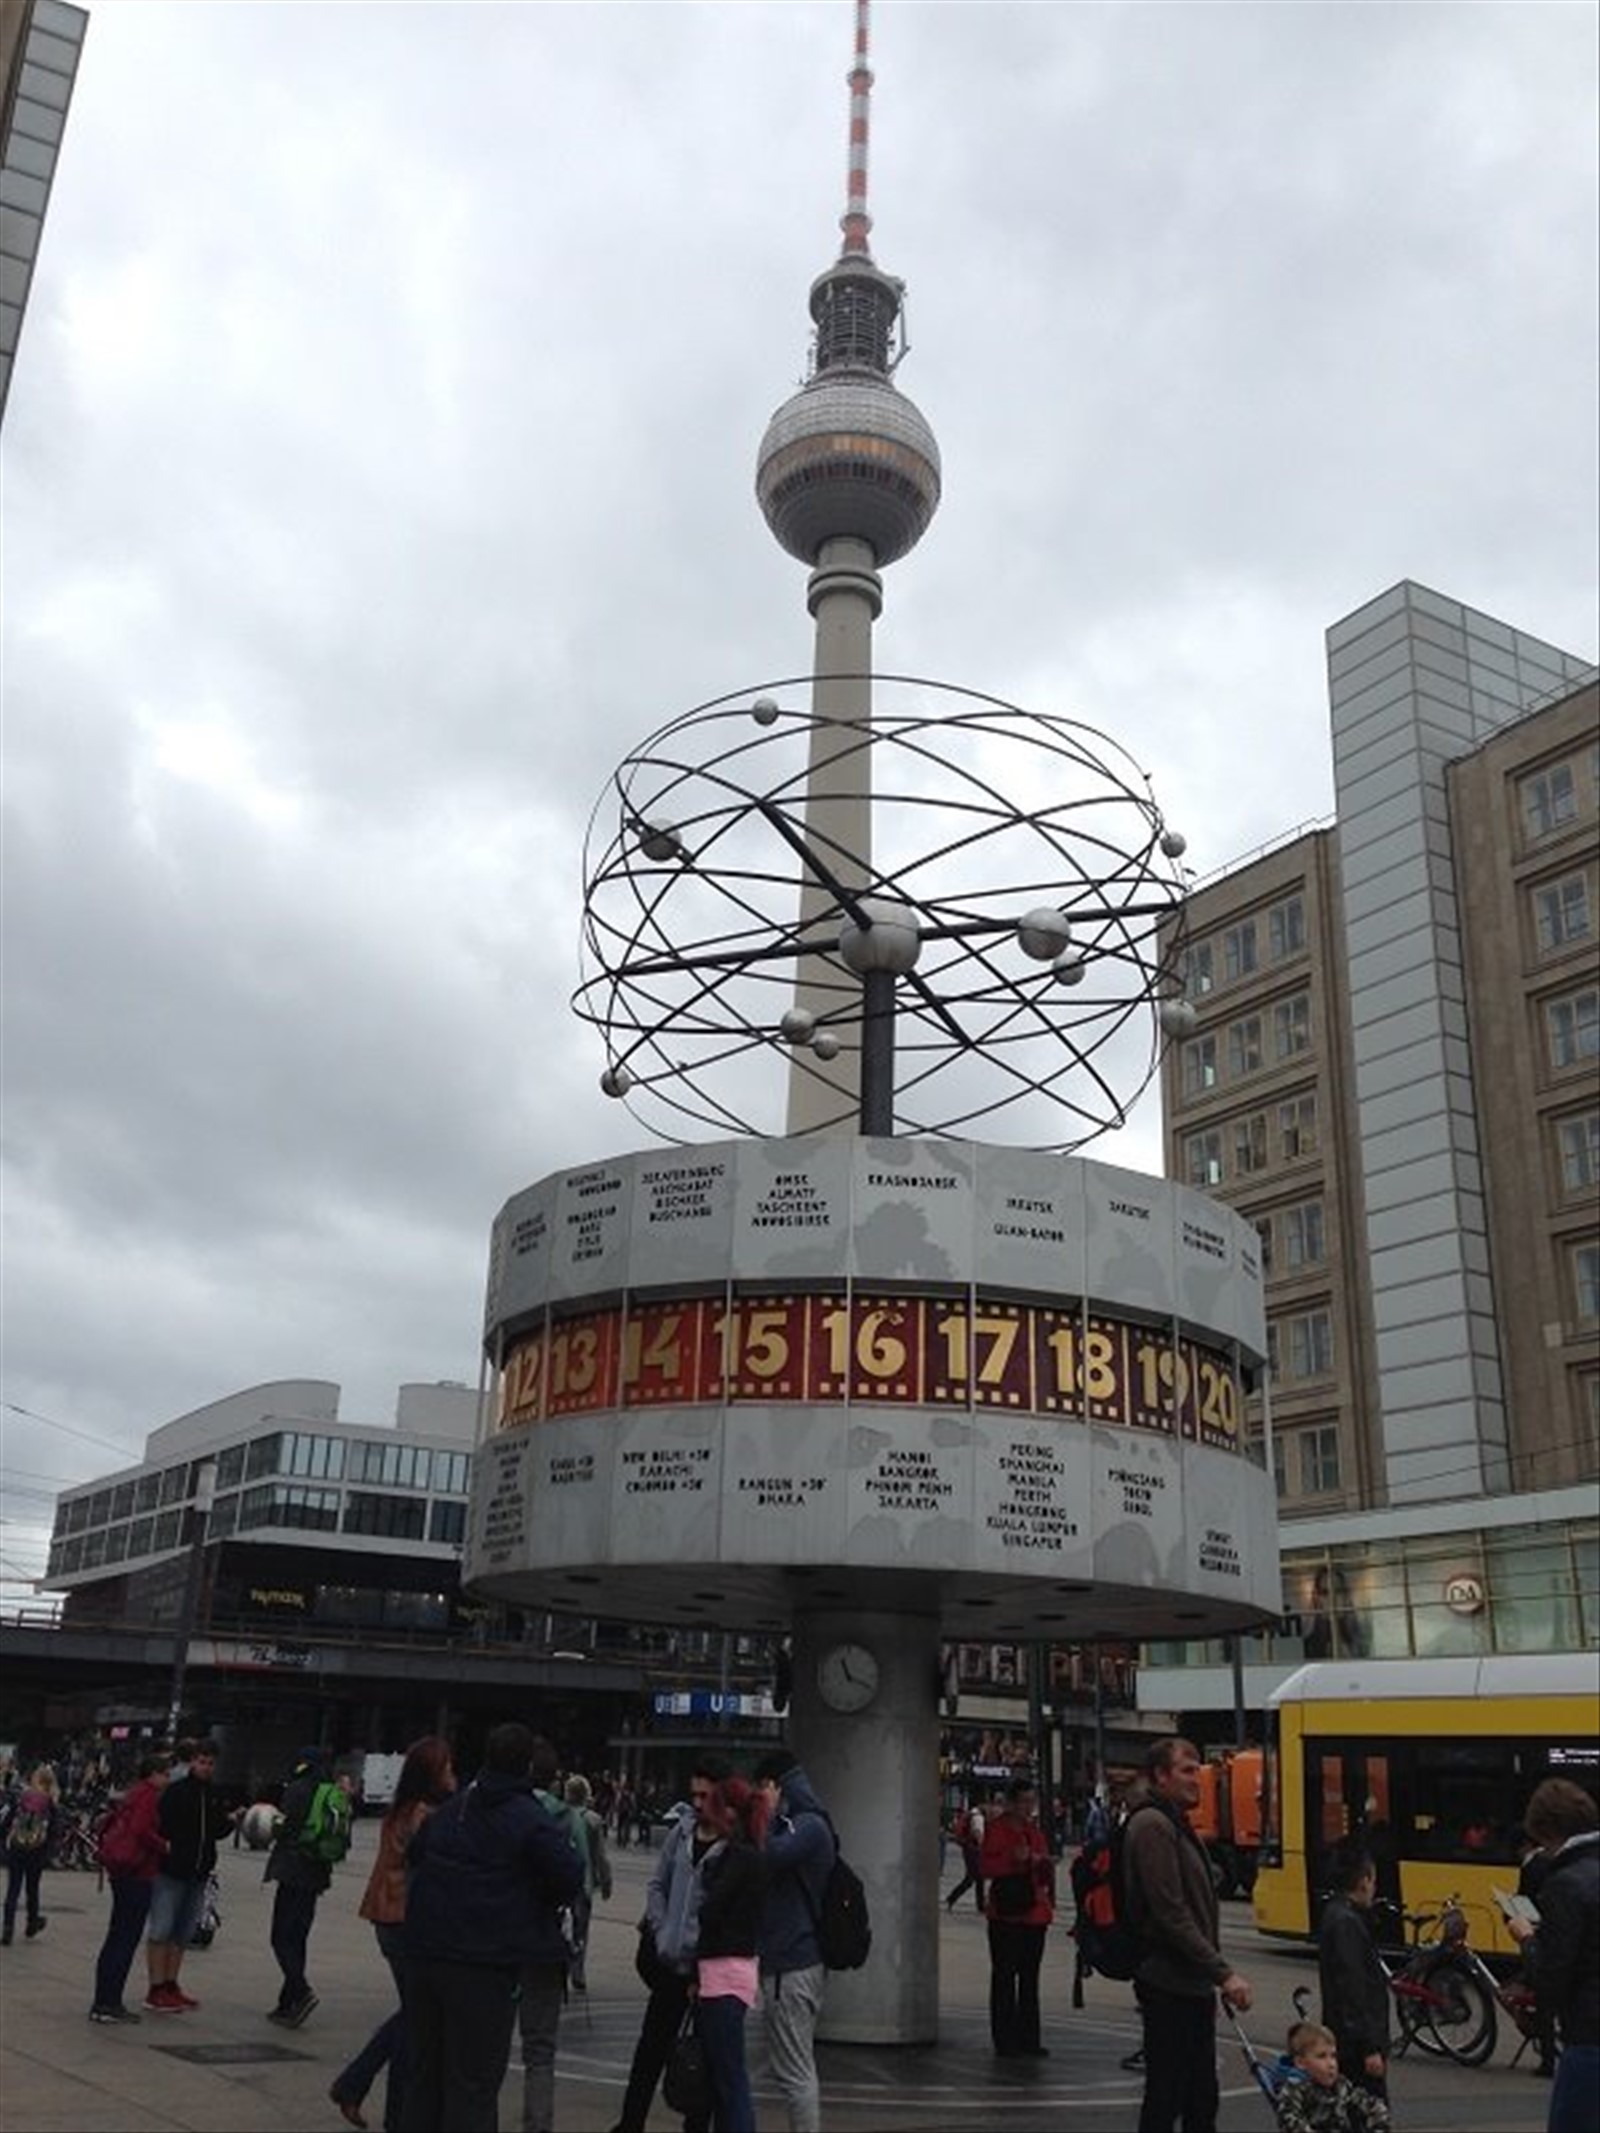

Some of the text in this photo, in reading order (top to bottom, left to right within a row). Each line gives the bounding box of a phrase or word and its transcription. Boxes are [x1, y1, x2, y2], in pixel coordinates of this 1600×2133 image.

[776, 1174, 808, 1186] OMSK
[868, 1174, 958, 1189] KRASNOJARSK
[768, 1188, 816, 1200] ALMATY
[757, 1201, 827, 1213] TASCHKENT
[751, 1215, 830, 1227] NOWOSIBIRSK
[623, 1315, 681, 1383] 14
[713, 1311, 789, 1378] 15
[822, 1310, 906, 1377] 16
[938, 1314, 1023, 1385] 17
[553, 1329, 597, 1395] 13
[1047, 1329, 1116, 1400] 18
[505, 1343, 540, 1411] 12
[1137, 1345, 1190, 1412] 19
[1201, 1362, 1237, 1434] 20
[888, 1451, 931, 1464] HANOI
[639, 1464, 694, 1478] KARACHI
[878, 1465, 939, 1480] BANGKOK
[999, 1457, 1065, 1475] SHANGHAI
[865, 1480, 952, 1496] PHNOM PENH
[1008, 1473, 1057, 1489] MANILA
[758, 1493, 806, 1507] DHAKA
[878, 1494, 939, 1511] JAKARTA
[1014, 1489, 1052, 1504] PERTH
[998, 1502, 1067, 1520] HONGKONG
[986, 1516, 1027, 1531] KUALA
[1002, 1532, 1062, 1550] SINGAPUR
